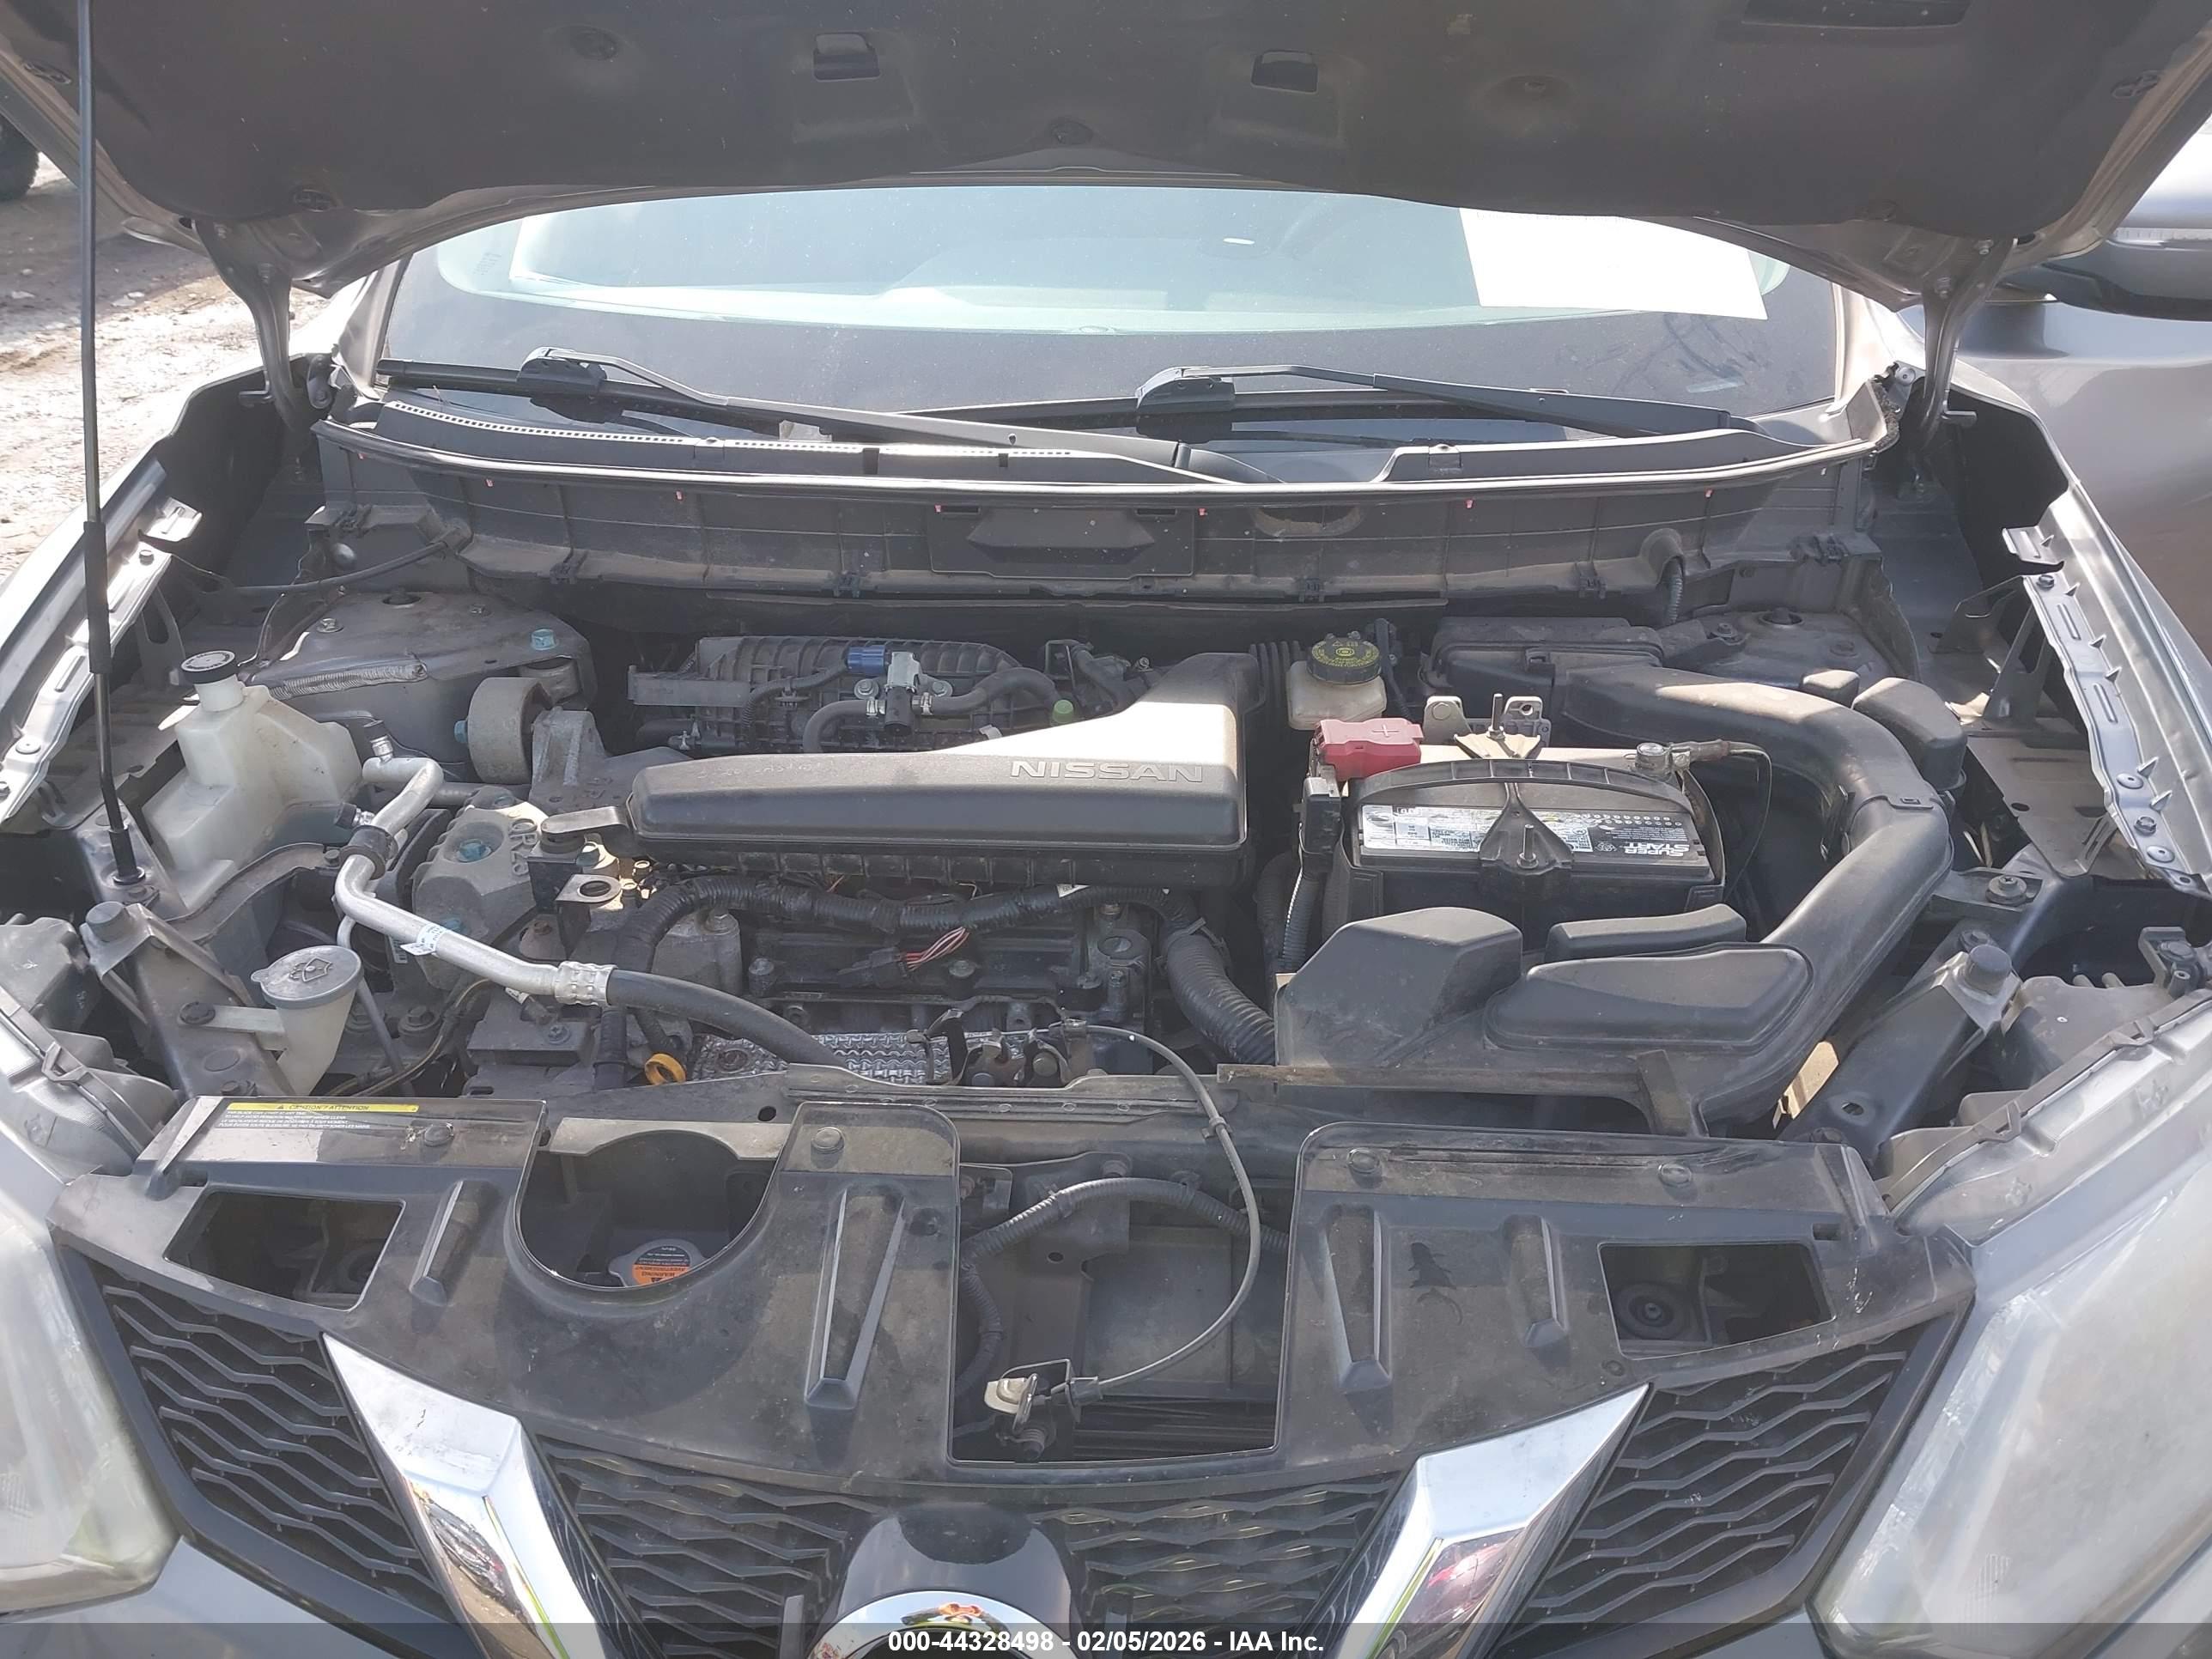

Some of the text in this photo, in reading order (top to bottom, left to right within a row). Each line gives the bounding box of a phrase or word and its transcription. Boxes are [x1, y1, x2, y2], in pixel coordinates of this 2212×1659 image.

[1010, 761, 1202, 782] NISSAN
[1623, 842, 1689, 852] START
[1625, 848, 1683, 857] SUPER
